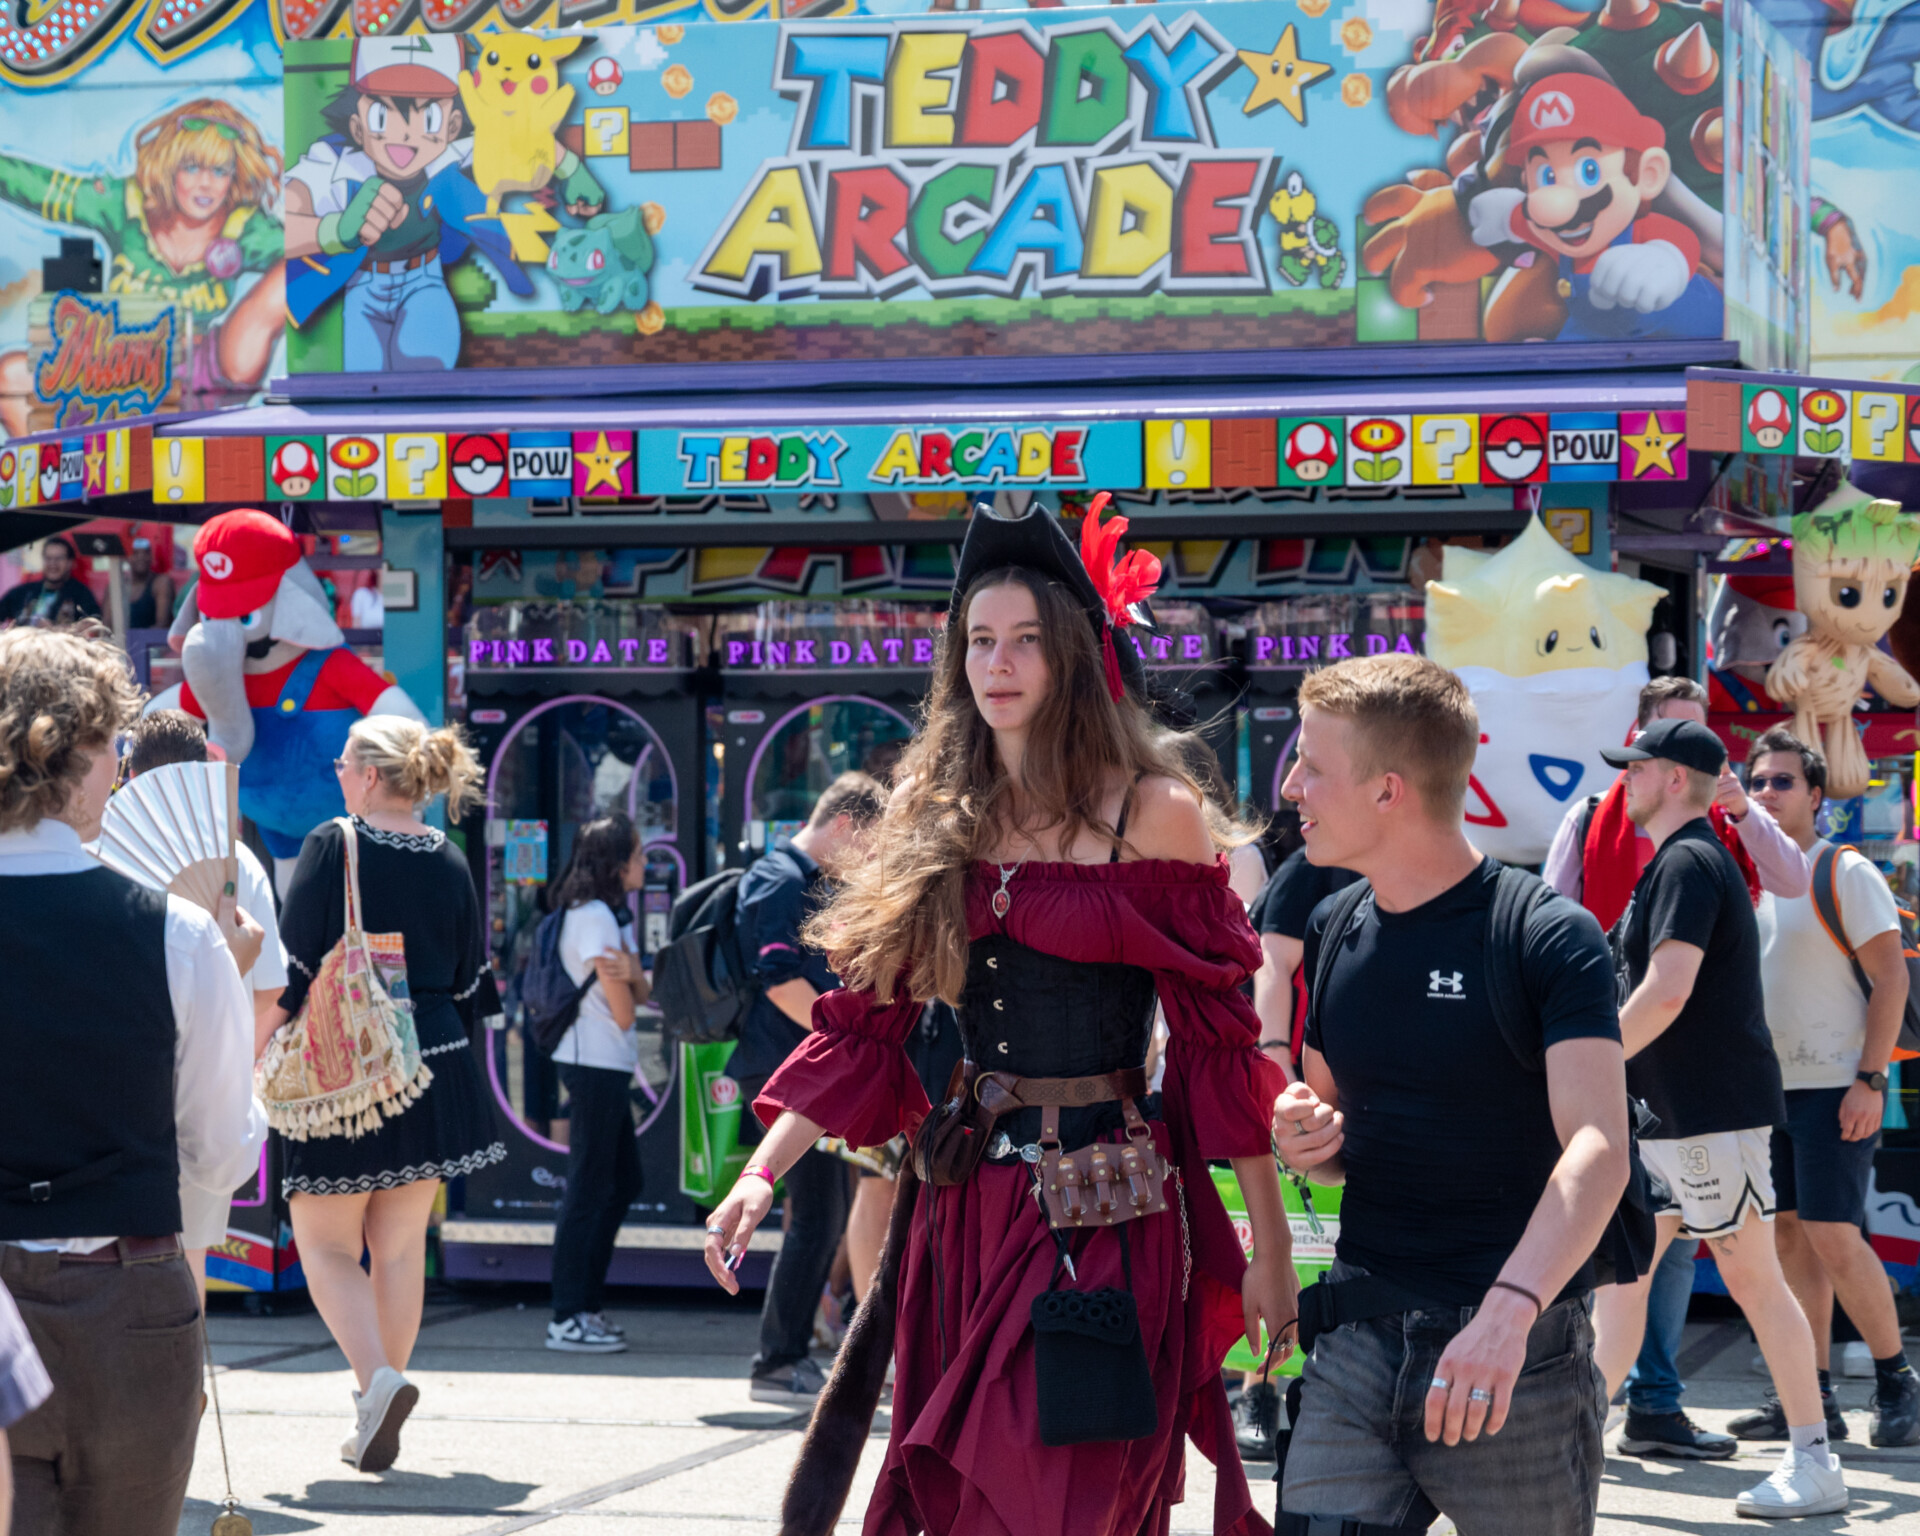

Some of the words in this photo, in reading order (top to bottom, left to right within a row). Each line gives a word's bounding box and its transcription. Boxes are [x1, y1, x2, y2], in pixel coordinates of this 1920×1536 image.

[773, 14, 1236, 151] TEDDY
[694, 155, 1272, 296] ARCADE
[678, 430, 848, 486] TEDDY
[867, 427, 1088, 484] ARCADE
[1552, 433, 1615, 461] POW
[512, 451, 568, 477] POW
[469, 639, 553, 663] PINK
[567, 639, 668, 663] DATE
[728, 640, 817, 665] PINK
[830, 638, 933, 664] DATE
[1256, 634, 1351, 660] PINK
[1292, 1233, 1335, 1246] RIENTAL
